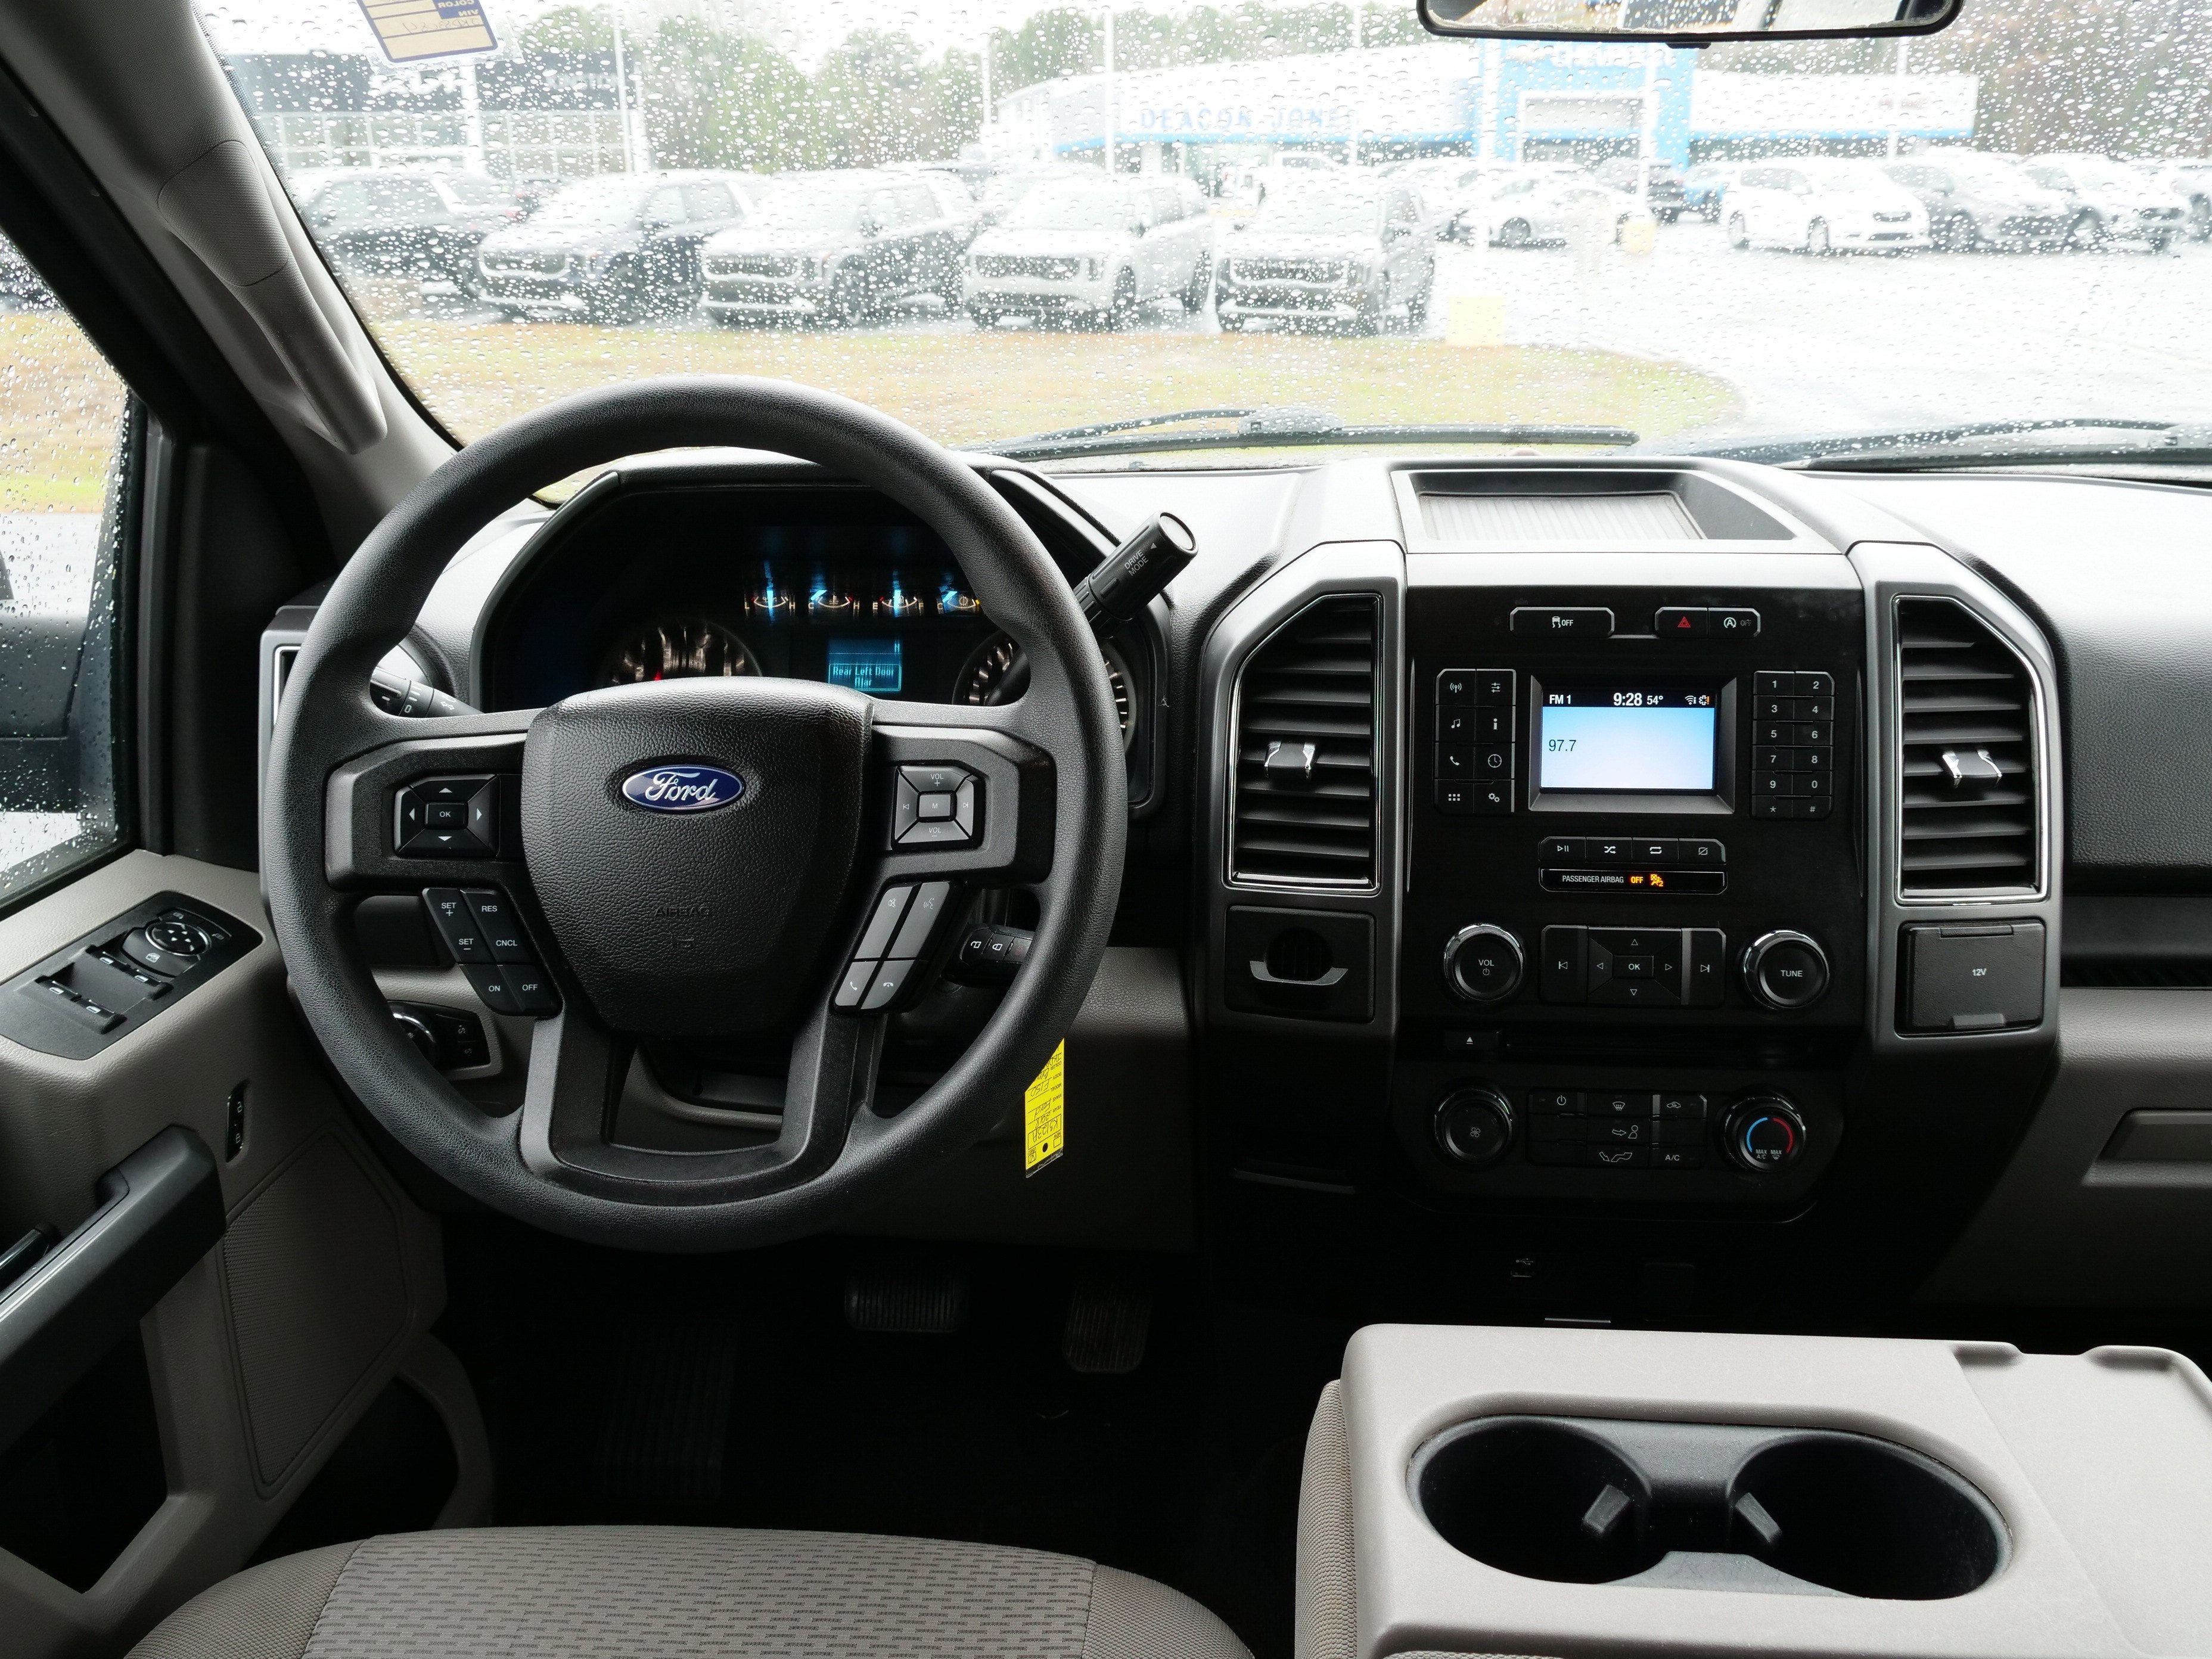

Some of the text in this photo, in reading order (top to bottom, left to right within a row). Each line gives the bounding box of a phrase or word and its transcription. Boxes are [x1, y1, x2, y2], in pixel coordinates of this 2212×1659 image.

[1140, 107, 1252, 130] DEACON
[1124, 549, 1144, 570] DRIVE
[1129, 555, 1149, 576] MODE
[833, 666, 894, 675] Rear Left Door
[1549, 695, 1571, 704] FM 1
[1613, 692, 1664, 706] 9:28 54°
[1771, 704, 1778, 713] 3
[1812, 731, 1818, 739] 6
[1549, 739, 1577, 751] 97.7
[1770, 755, 1776, 763] 7
[1812, 755, 1818, 763] 8
[644, 771, 718, 803] Ford
[1770, 779, 1776, 788] 9
[1812, 779, 1818, 788] 0
[1050, 1061, 1062, 1070] COLOR
[1052, 1071, 1062, 1080] BODY
